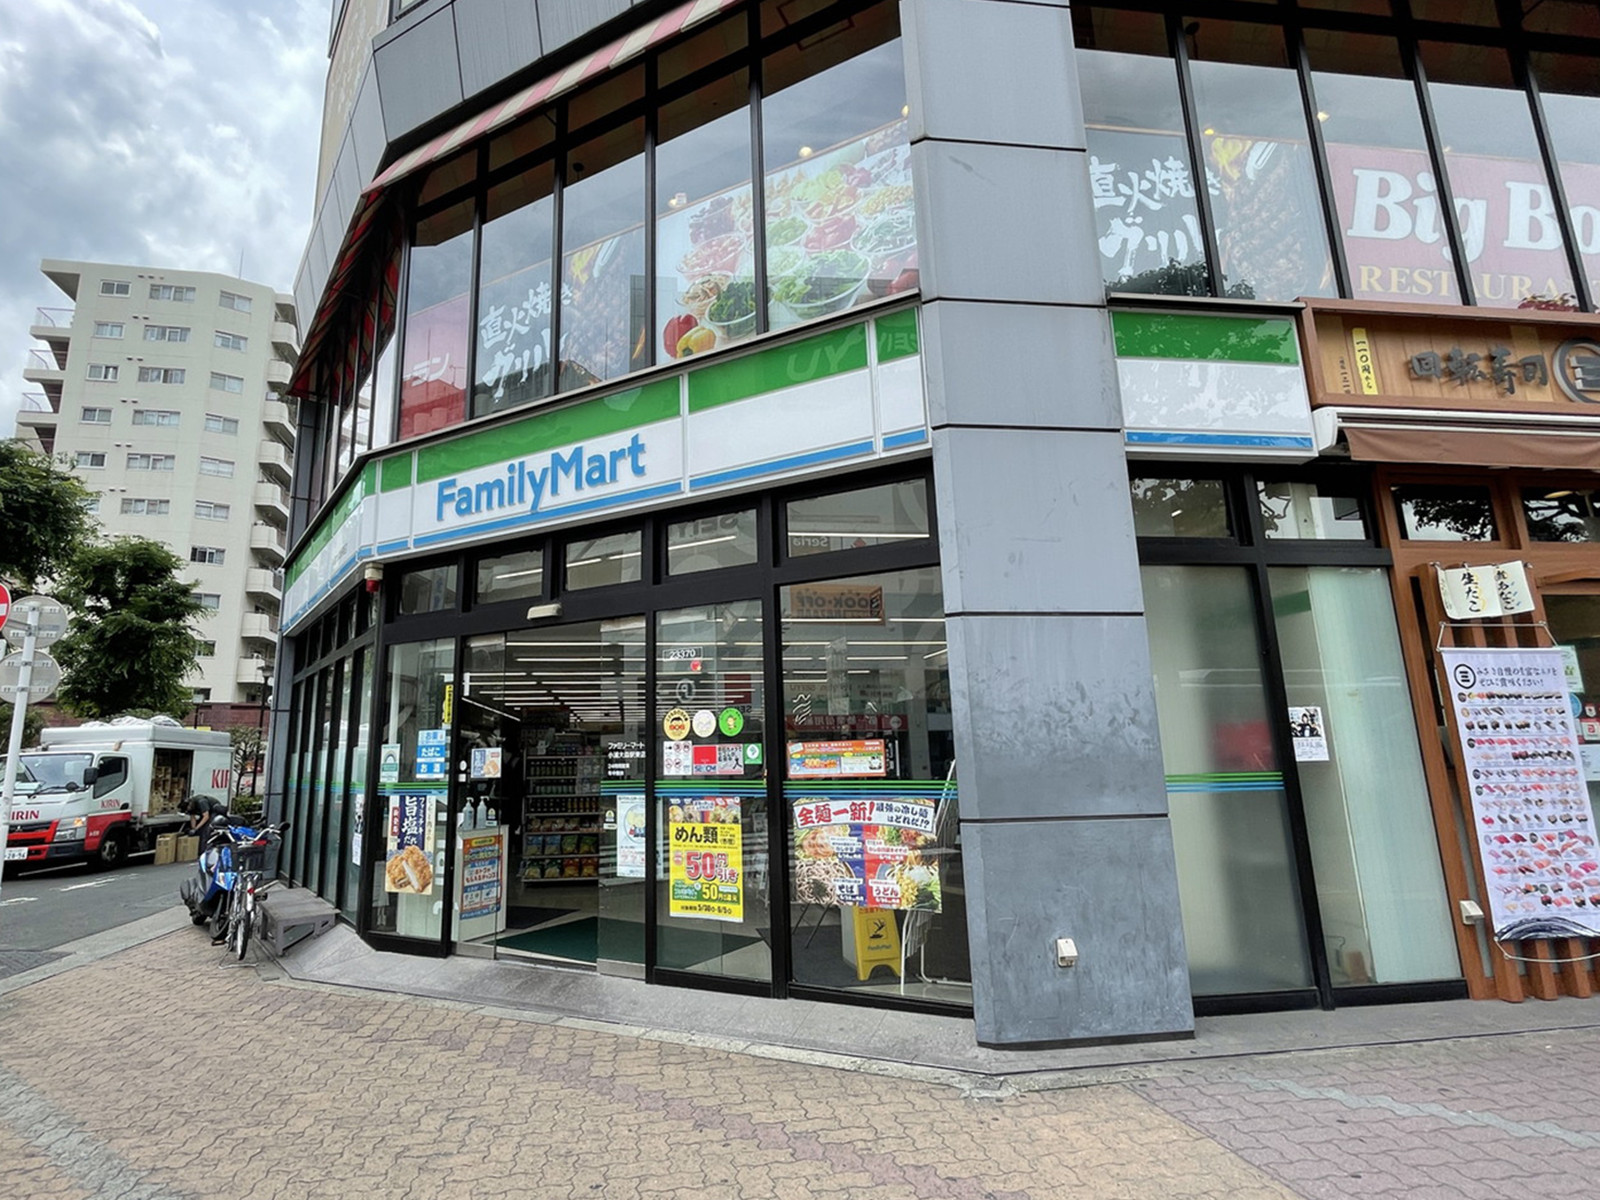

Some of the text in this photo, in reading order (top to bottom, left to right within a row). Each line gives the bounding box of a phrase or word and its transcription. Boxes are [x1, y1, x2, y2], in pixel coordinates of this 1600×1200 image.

[1347, 168, 1488, 264] Big
[480, 282, 573, 349] 直火焼き
[1411, 344, 1548, 395] 回転寿司
[437, 432, 647, 522] FamilyMart
[1461, 572, 1481, 613] 生たこ
[421, 746, 440, 757] たばこ
[101, 800, 120, 809] KIRIN
[797, 801, 876, 826] 全麺一新!
[11, 810, 40, 821] IRIN
[674, 827, 719, 845] めん類
[838, 885, 855, 895] そば
[874, 886, 899, 897] うどん
